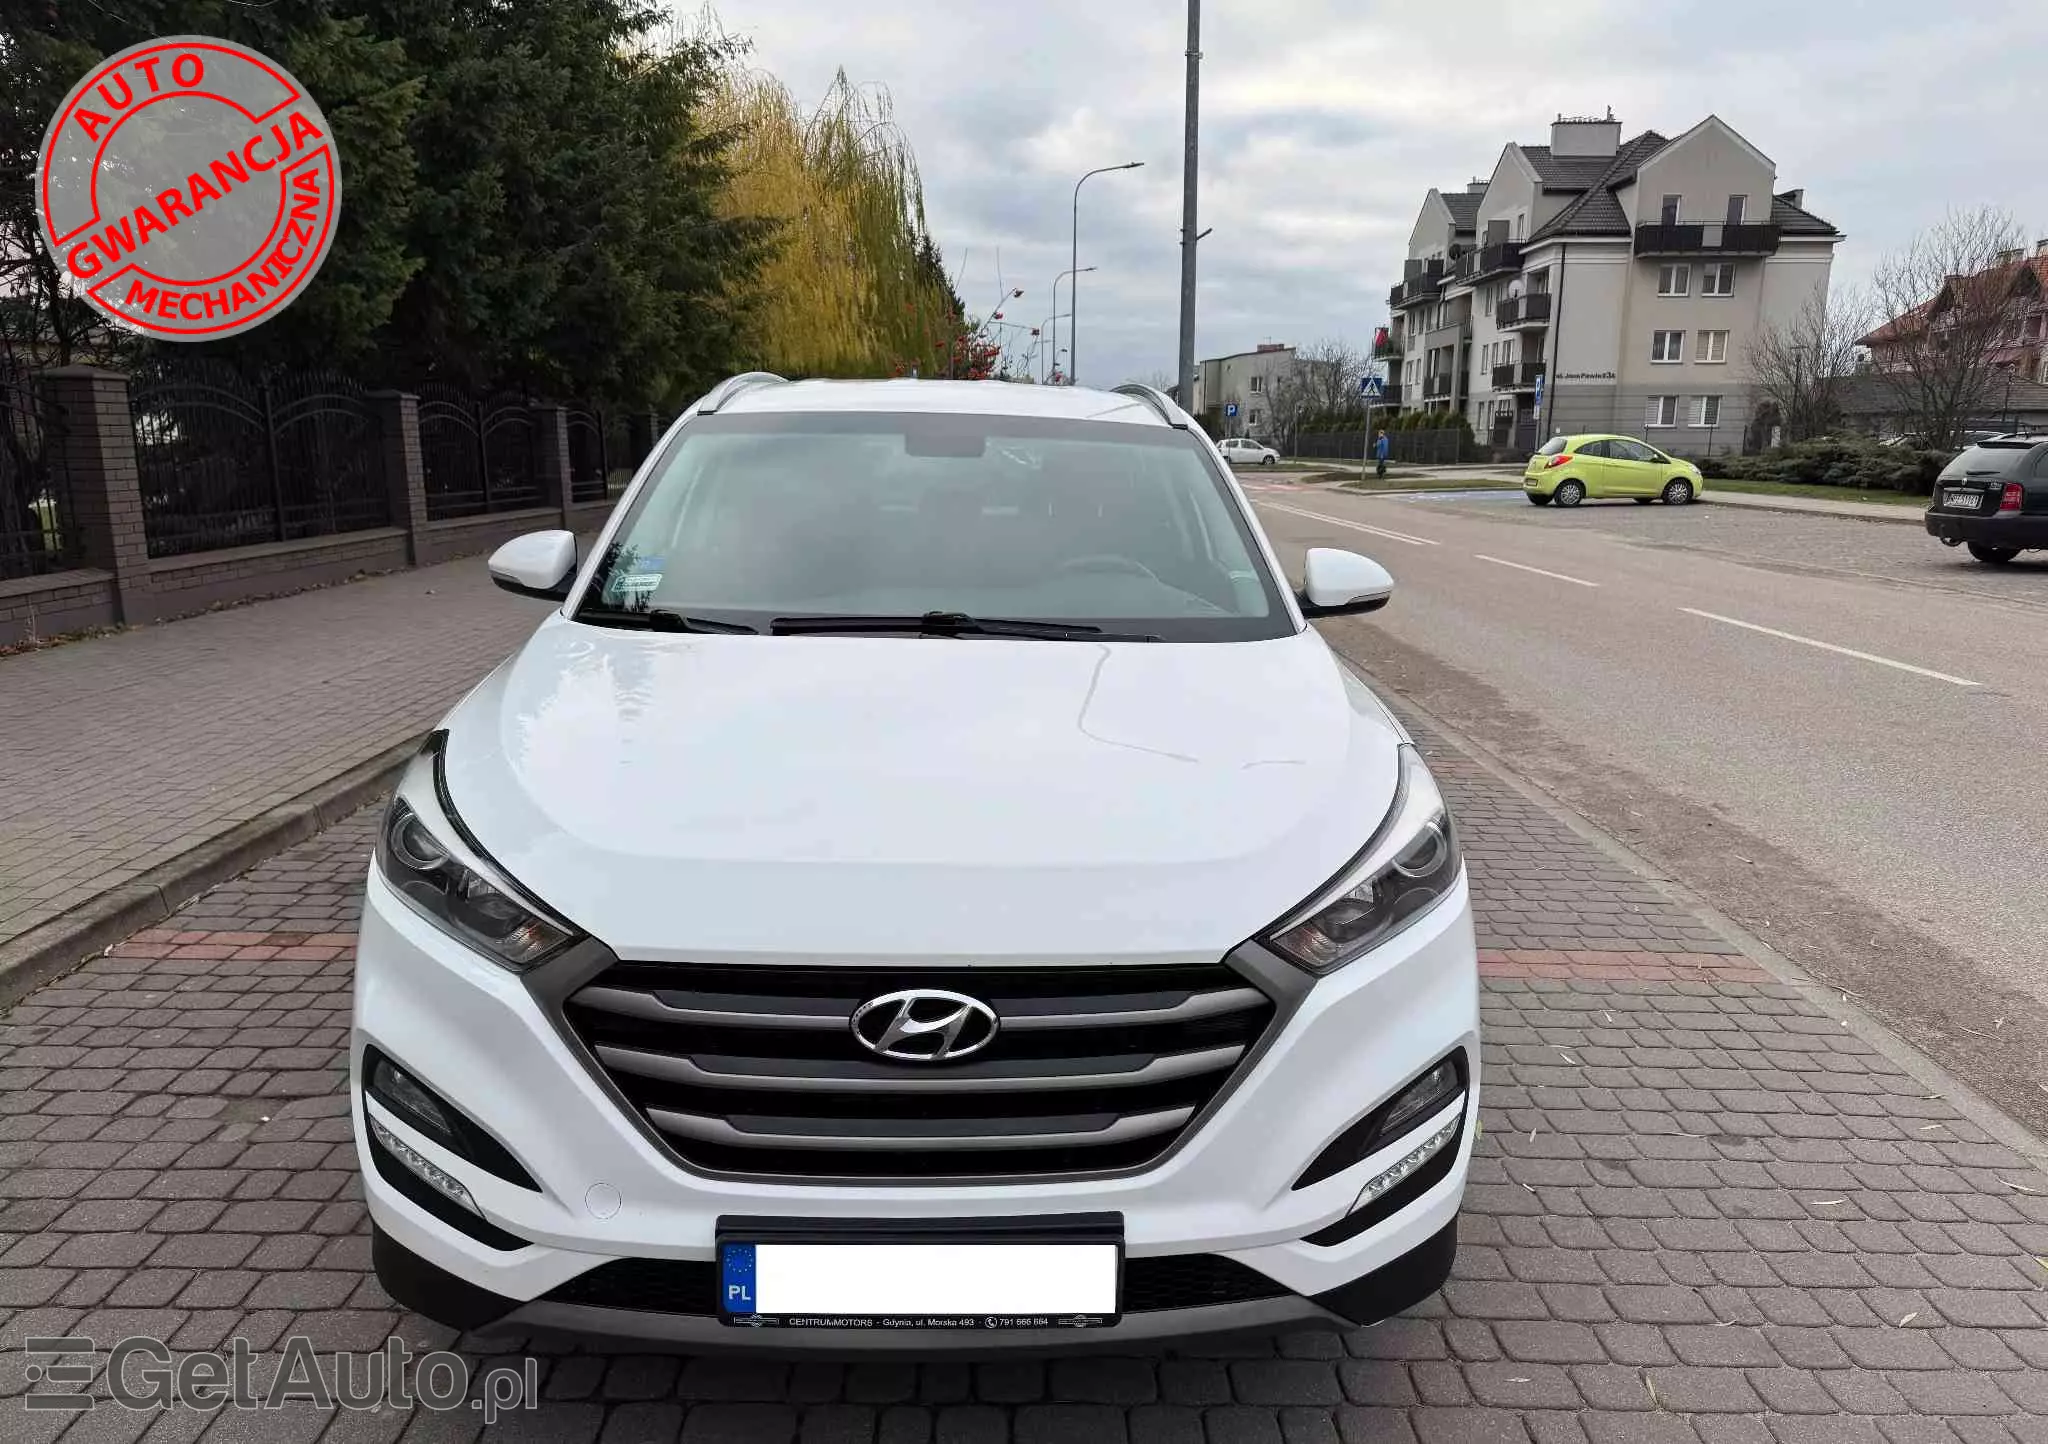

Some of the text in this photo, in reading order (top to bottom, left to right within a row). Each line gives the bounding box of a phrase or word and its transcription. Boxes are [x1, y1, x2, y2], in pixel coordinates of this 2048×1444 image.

[1227, 405, 1236, 416] P
[728, 1284, 752, 1300] PL
[927, 1318, 957, 1327] Morska
[959, 1318, 975, 1327] 493
[1000, 1317, 1014, 1326] 791
